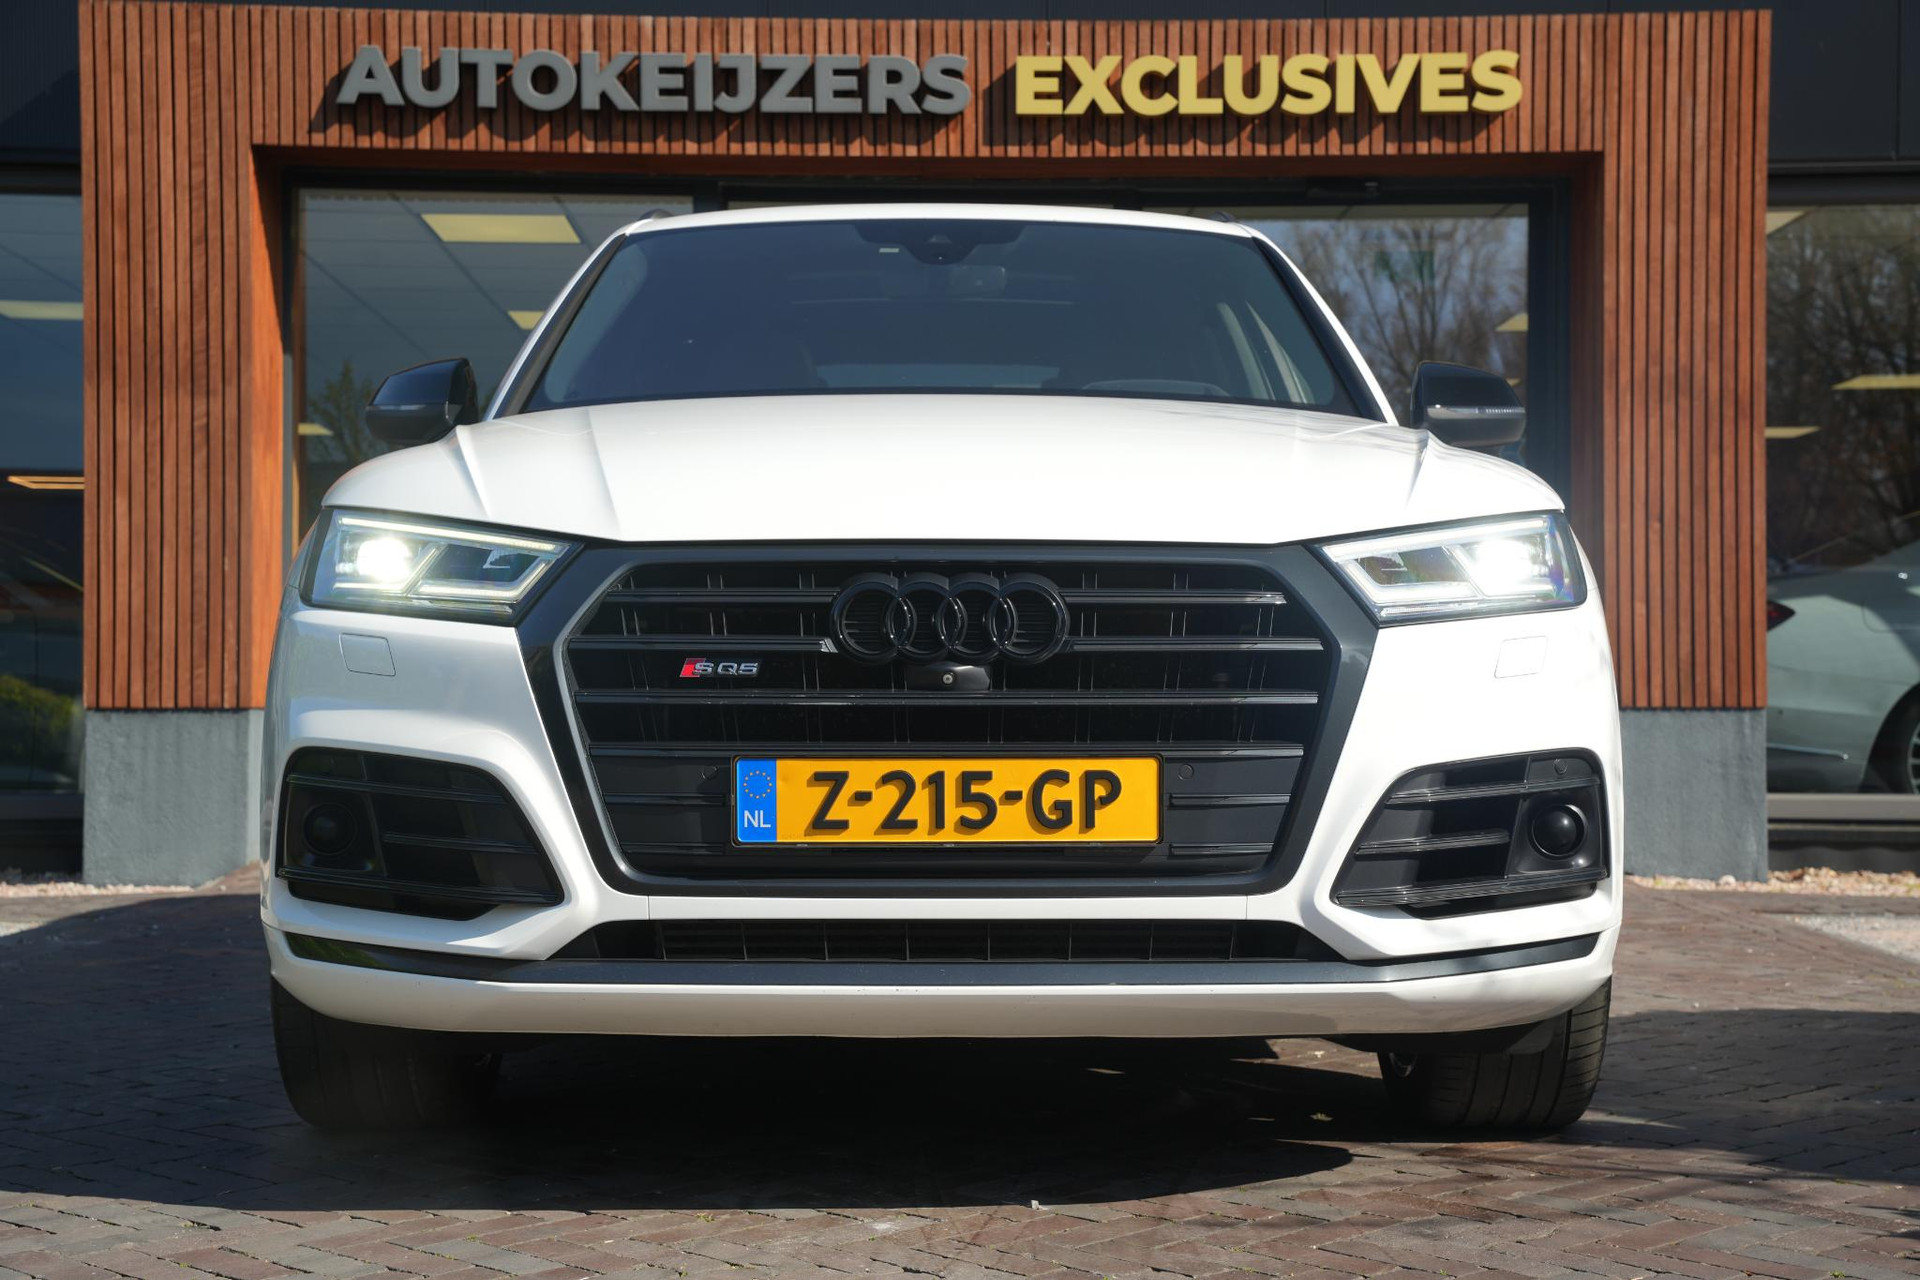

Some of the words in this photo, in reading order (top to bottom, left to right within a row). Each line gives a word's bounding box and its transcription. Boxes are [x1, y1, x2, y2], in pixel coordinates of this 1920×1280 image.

[336, 45, 972, 115] AUTOKEIJZERS
[1015, 50, 1523, 116] EXCLUSIVES
[743, 809, 771, 828] NL
[811, 769, 1122, 831] Z-215-GP
